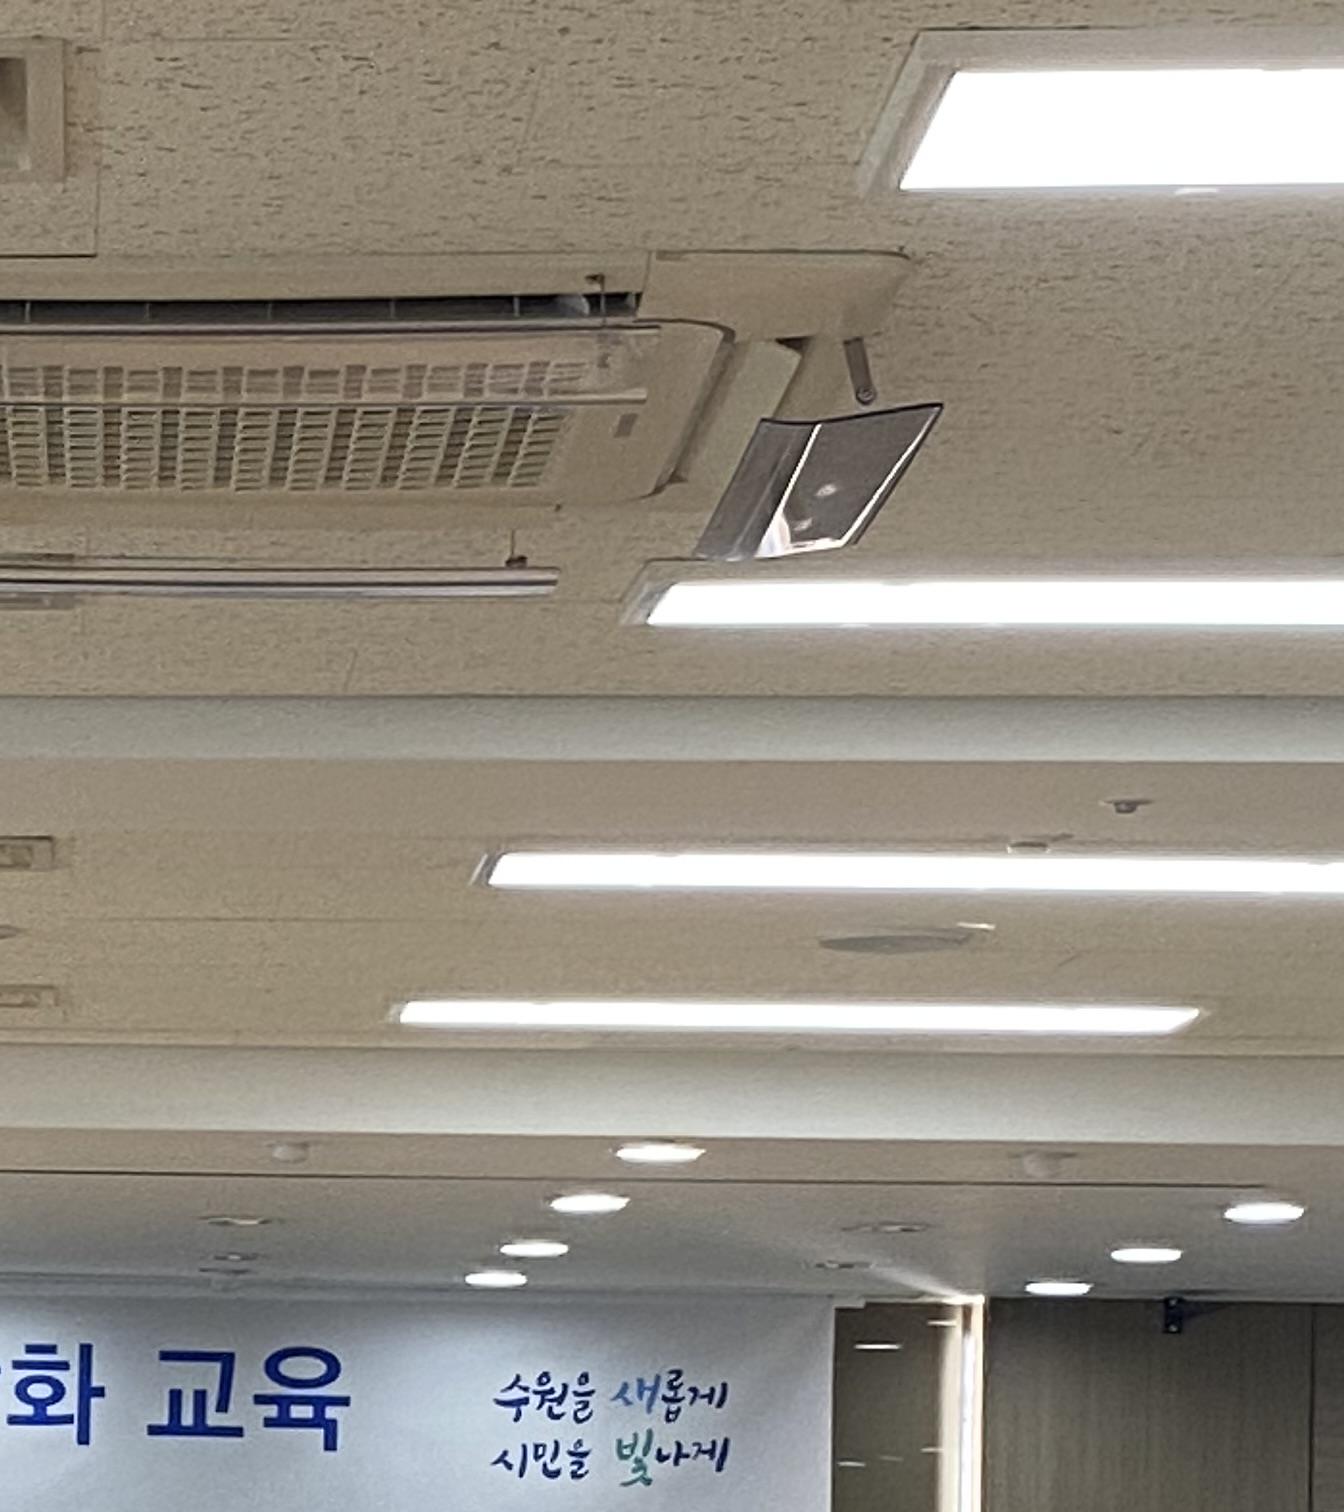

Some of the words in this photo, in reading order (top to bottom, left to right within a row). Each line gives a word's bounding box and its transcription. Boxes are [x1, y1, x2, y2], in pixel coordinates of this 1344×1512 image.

[146, 1346, 352, 1452] 교육
[492, 1371, 596, 1425] 수원을
[611, 1368, 728, 1424] 새롭게
[490, 1438, 592, 1481] 시민을
[615, 1430, 731, 1487] 빛나게
